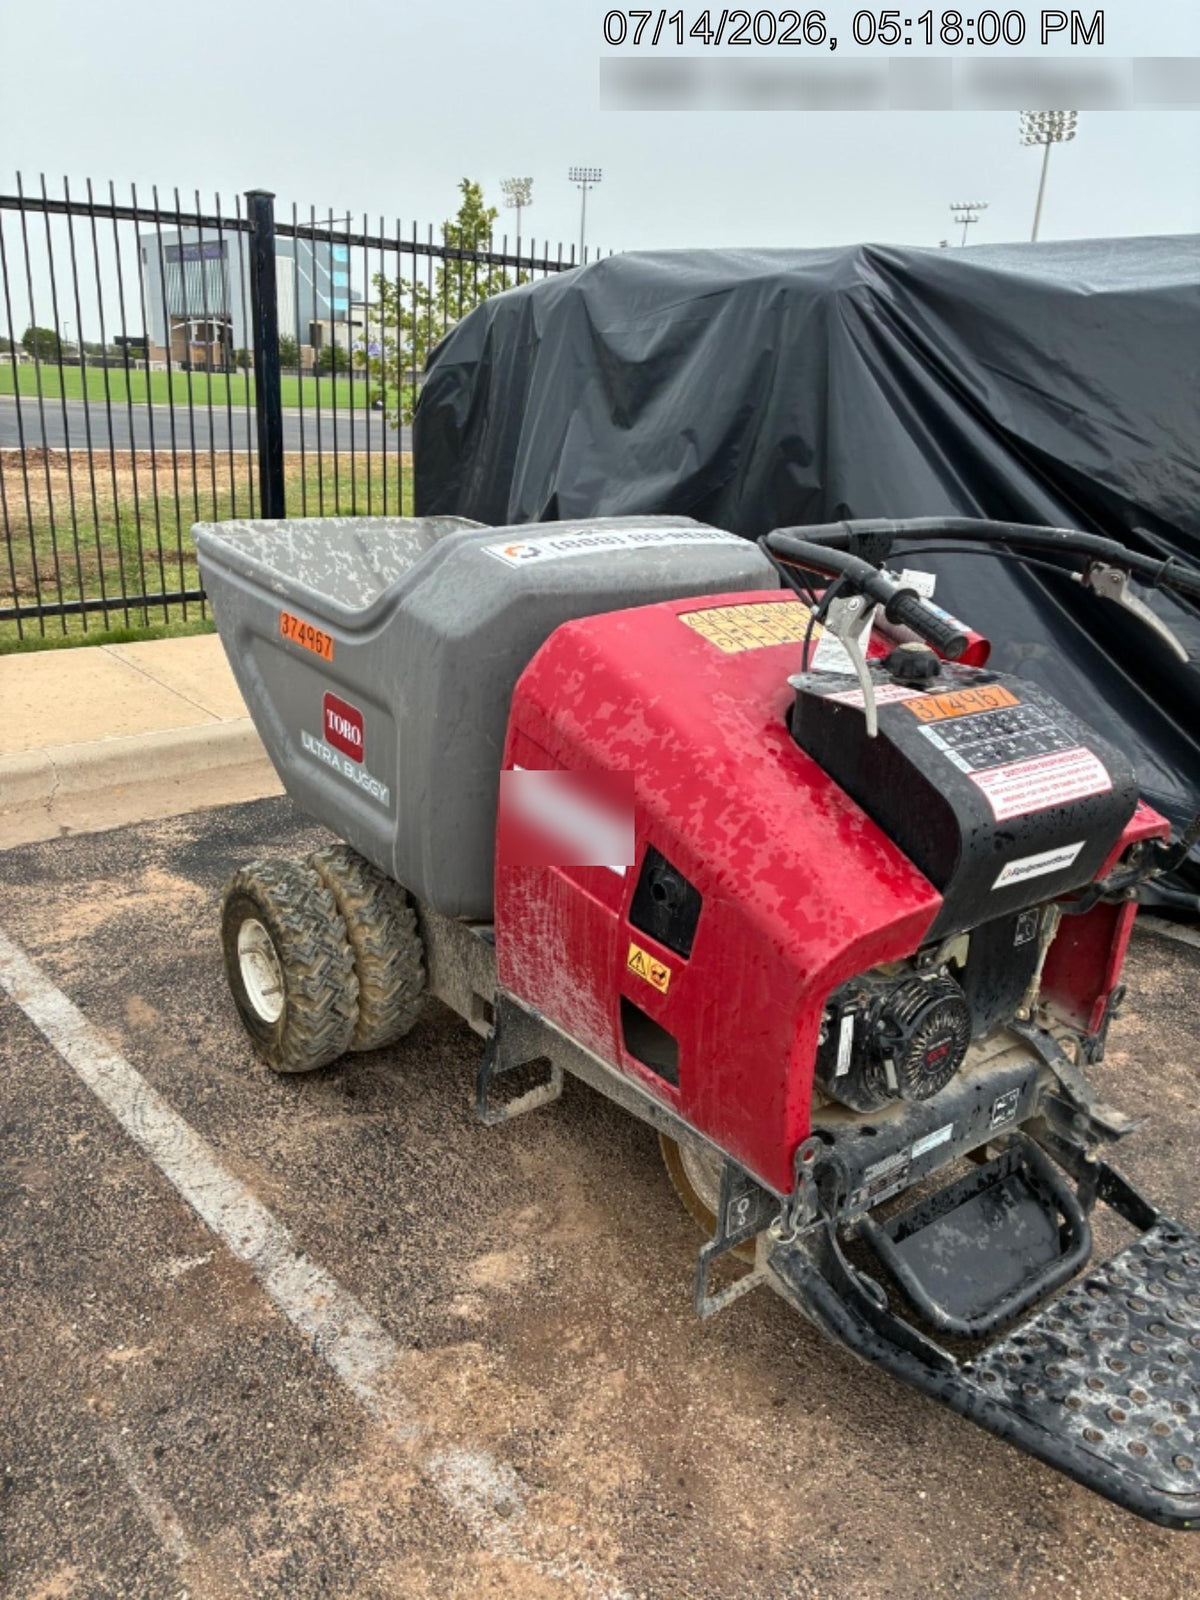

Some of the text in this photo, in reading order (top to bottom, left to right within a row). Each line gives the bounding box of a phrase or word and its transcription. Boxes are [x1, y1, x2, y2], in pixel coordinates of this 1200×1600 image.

[281, 612, 332, 658] 374967
[908, 686, 1010, 719] 374967
[326, 709, 362, 746] TORO
[303, 731, 388, 802] ULTRA BUGGY
